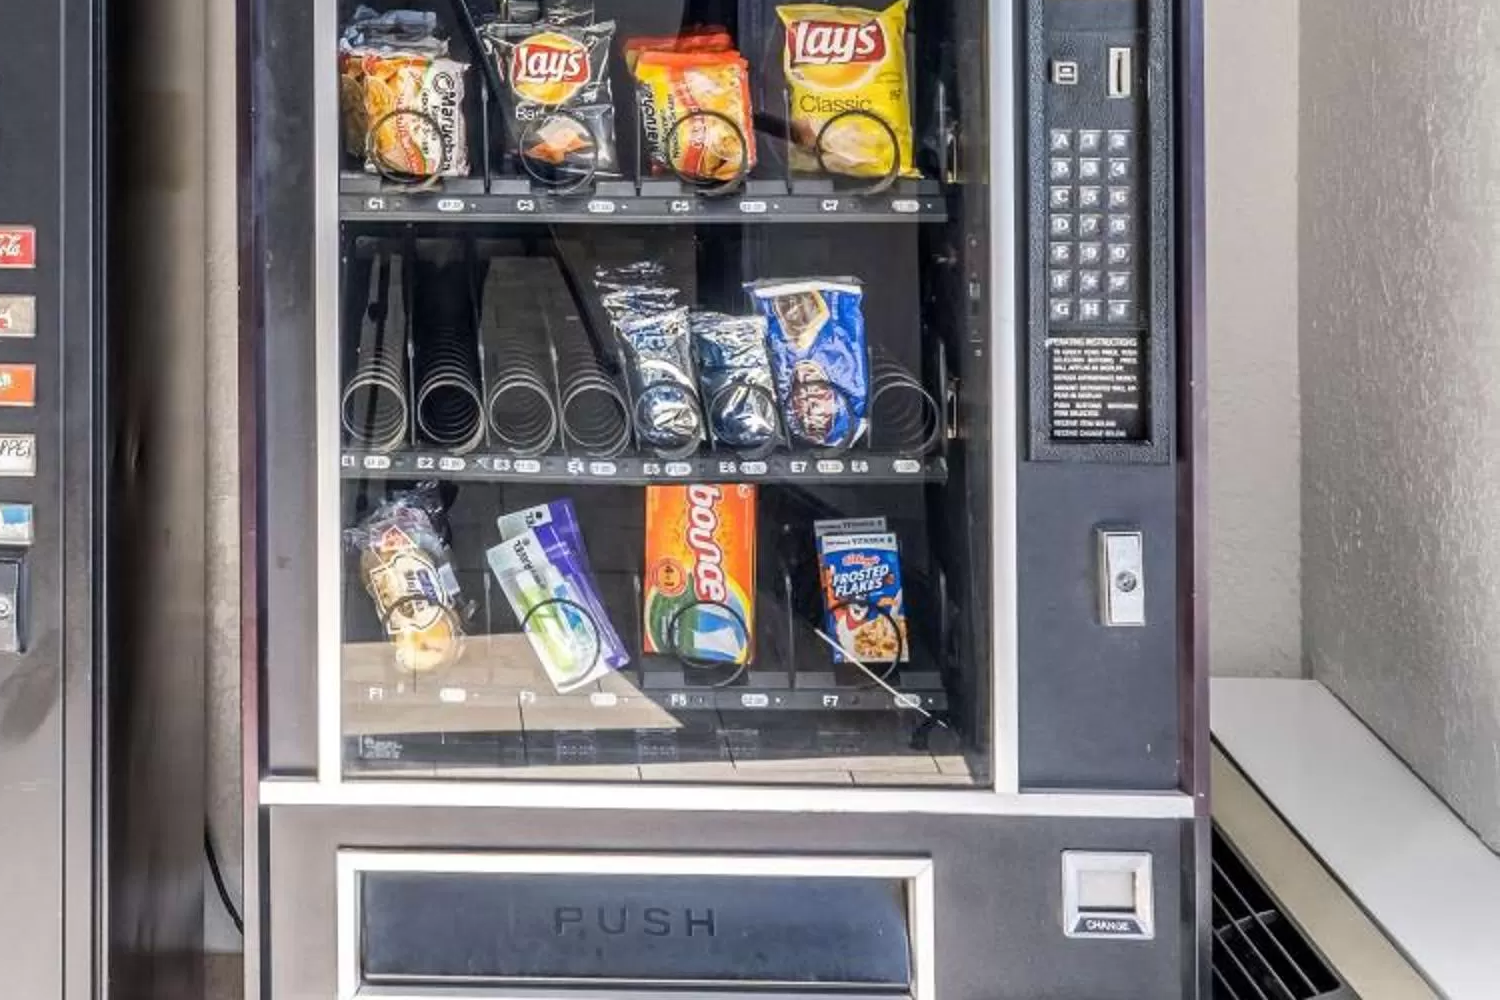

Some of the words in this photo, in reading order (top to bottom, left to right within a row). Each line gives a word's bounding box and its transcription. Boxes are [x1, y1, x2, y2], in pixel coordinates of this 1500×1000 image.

[800, 94, 871, 112] Classic
[822, 200, 839, 211] C7
[791, 461, 806, 472] E7
[690, 484, 724, 602] bounce
[833, 564, 889, 587] FROSTED
[836, 578, 883, 597] FLAKES
[555, 904, 717, 936] PUSH
[1086, 920, 1130, 931] CHANGE
